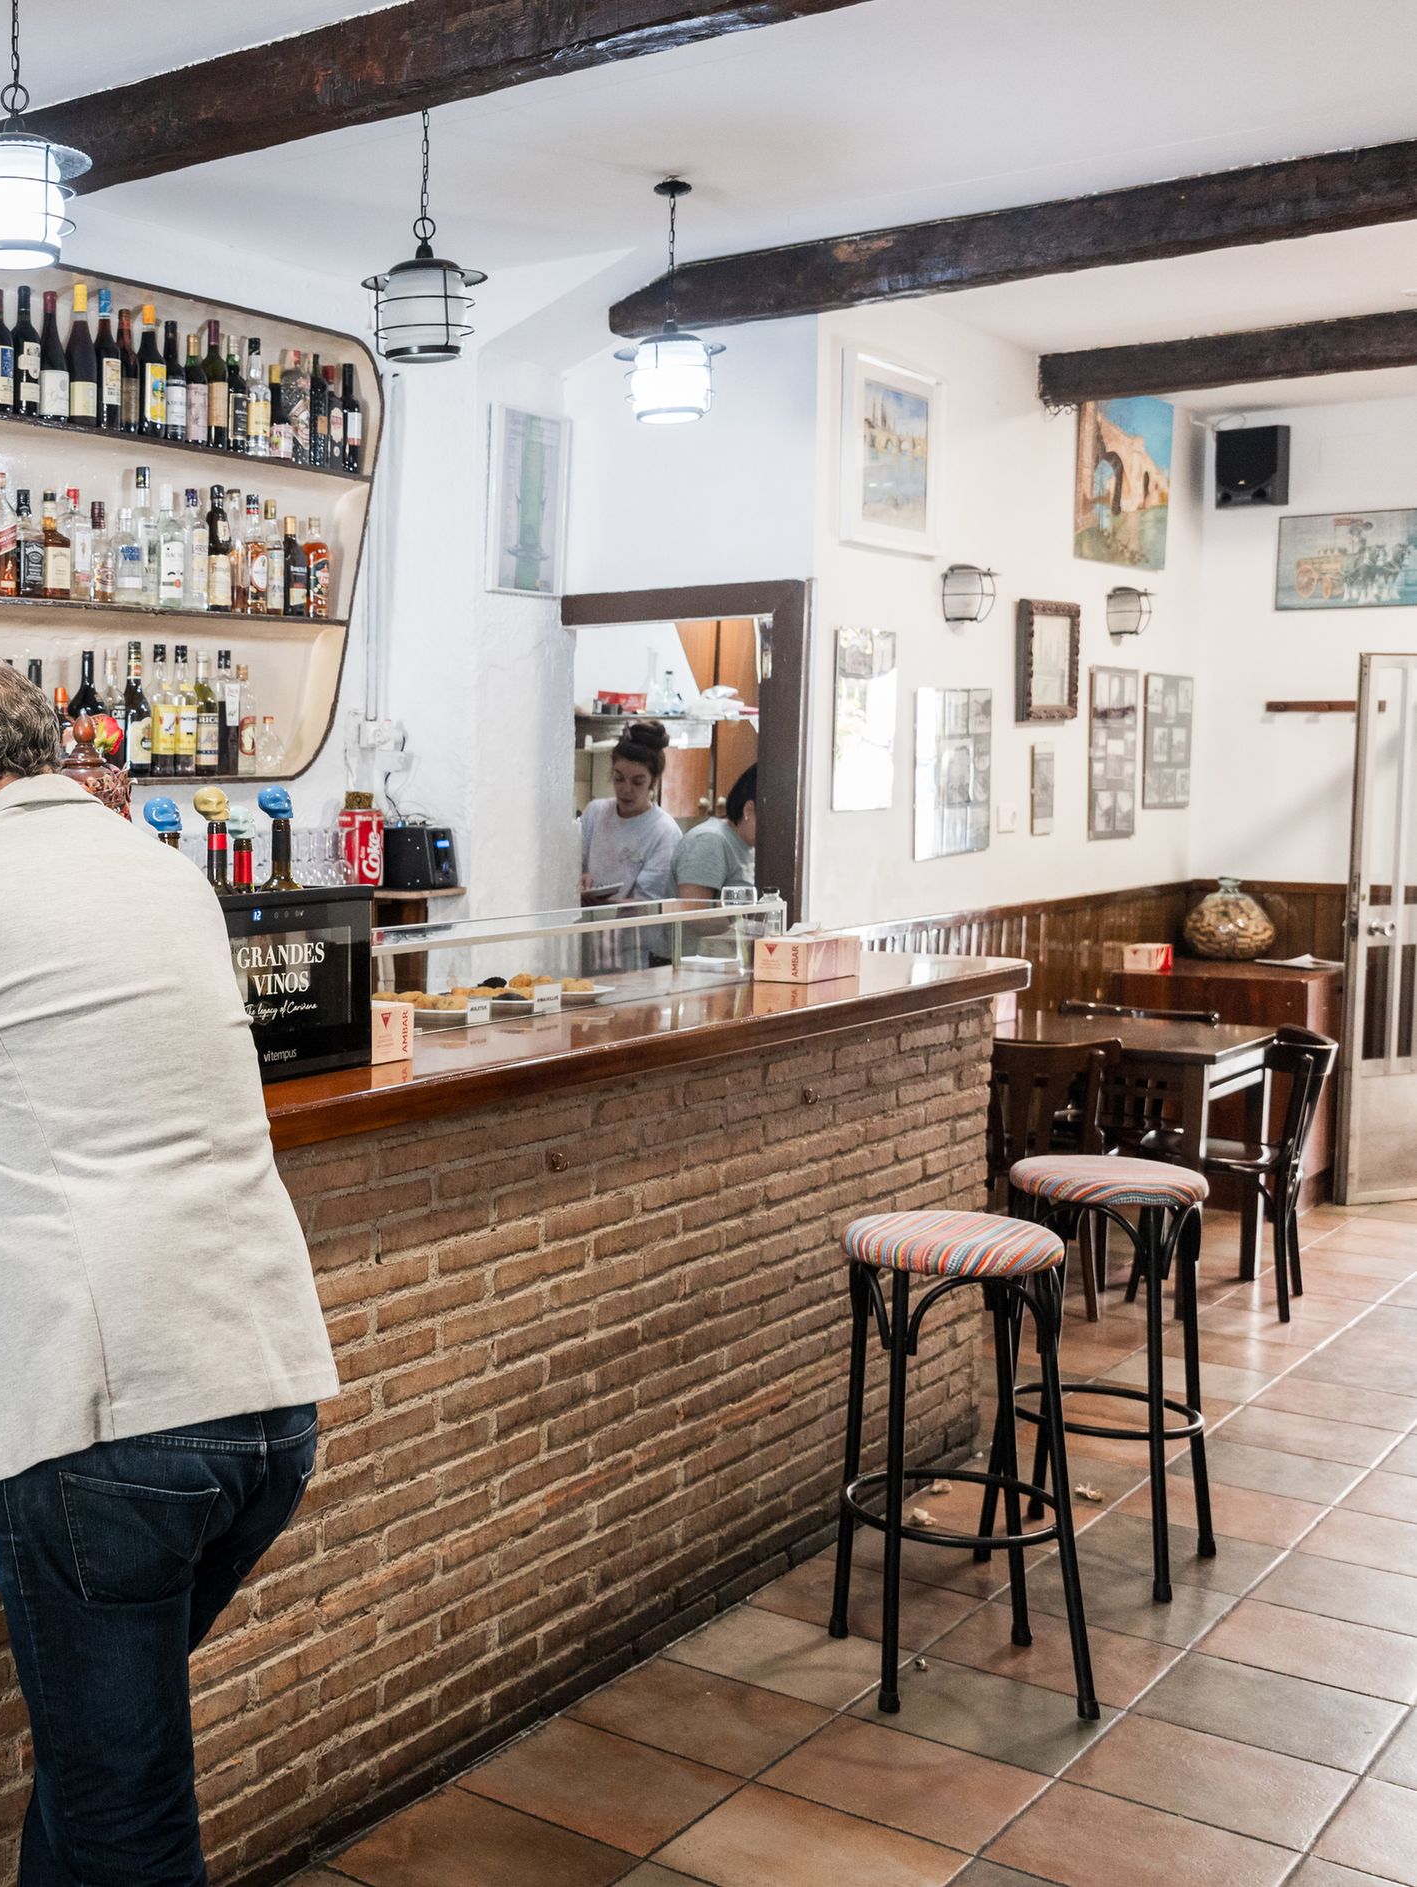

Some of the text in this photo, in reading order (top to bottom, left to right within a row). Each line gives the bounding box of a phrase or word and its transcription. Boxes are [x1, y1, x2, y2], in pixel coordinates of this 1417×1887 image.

[362, 831, 380, 880] Coke
[236, 941, 326, 969] GRANDES
[791, 944, 800, 978] AMBAR
[252, 971, 311, 997] VINOS
[257, 1003, 278, 1020] legacy
[279, 999, 289, 1018] of
[401, 1010, 409, 1053] AMBAR
[263, 1048, 298, 1063] vitempus
